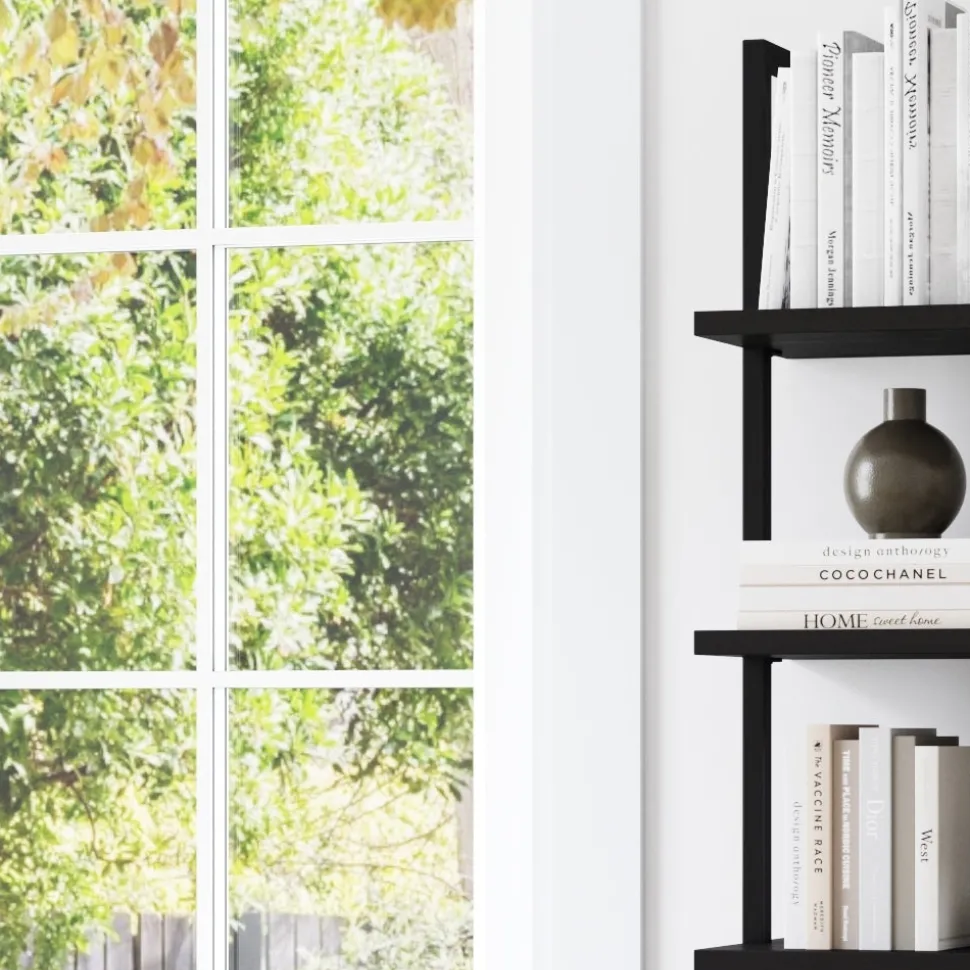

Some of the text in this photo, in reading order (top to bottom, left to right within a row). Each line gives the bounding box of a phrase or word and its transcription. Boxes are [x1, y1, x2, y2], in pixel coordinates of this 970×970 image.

[821, 41, 842, 176] Pioneer Memoirs
[826, 231, 837, 306] Morgan Jennings
[822, 545, 951, 560] design anthology
[804, 610, 941, 629] HOME sweet home
[841, 750, 851, 772] TIME
[813, 756, 823, 874] The VACCINE RACE
[841, 786, 851, 814] PLACE
[791, 801, 804, 841] design
[841, 821, 851, 853] NORDIC
[866, 799, 885, 841] Dior
[920, 829, 933, 864] West
